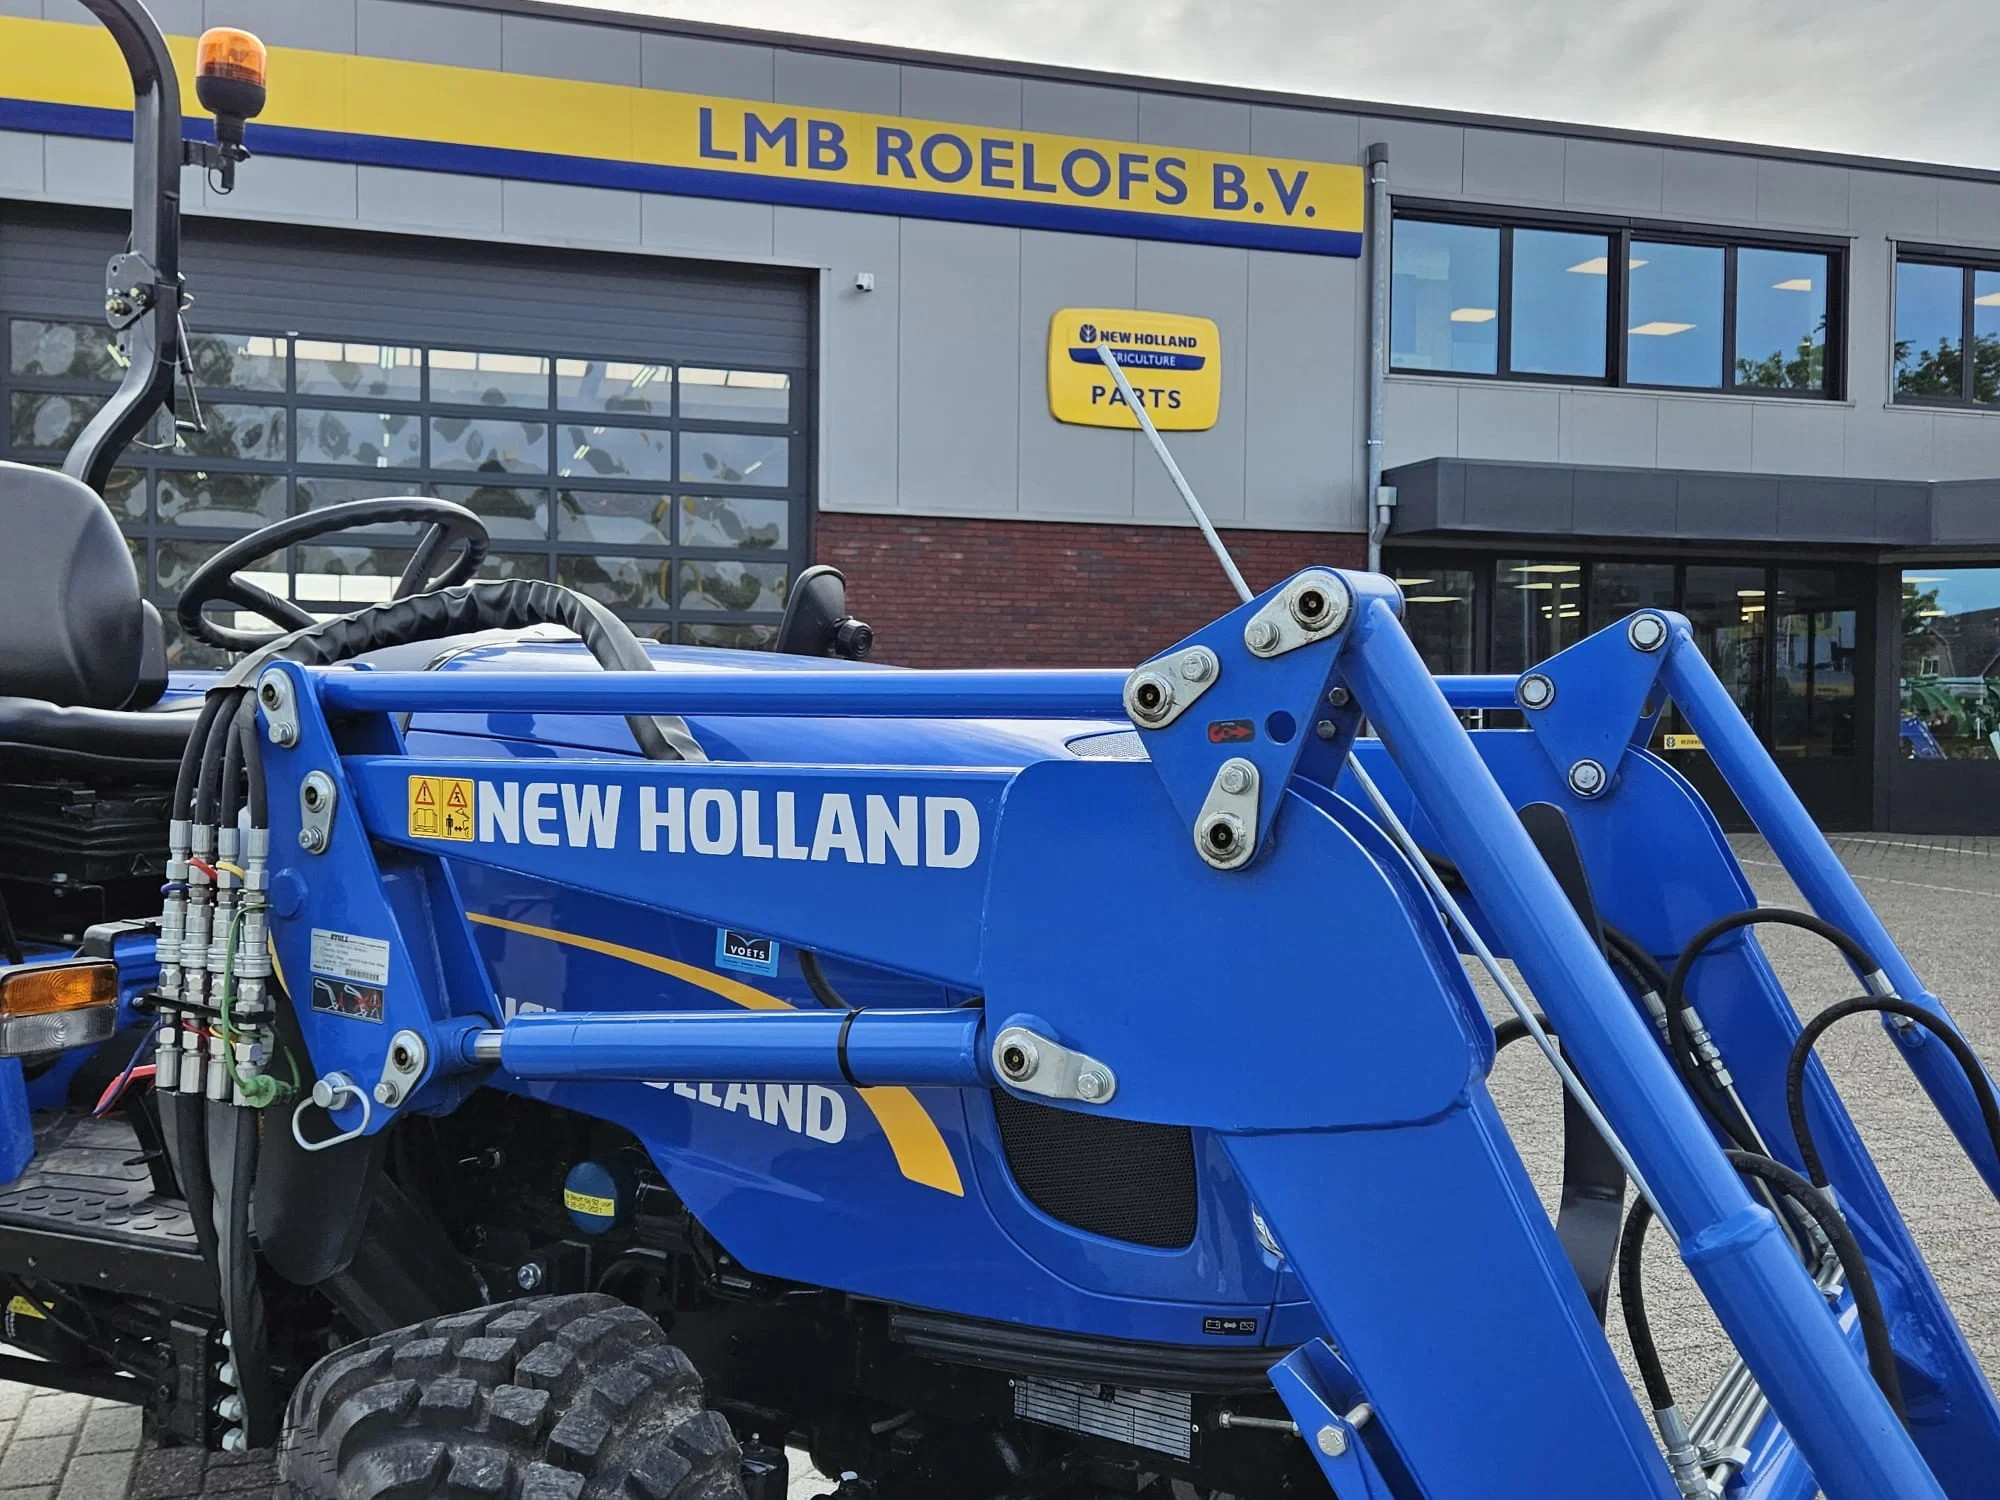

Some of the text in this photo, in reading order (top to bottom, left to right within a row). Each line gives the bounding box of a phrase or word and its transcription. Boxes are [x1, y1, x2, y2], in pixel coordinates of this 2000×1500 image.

[699, 107, 1317, 218] LMB ROELOFS B.V.
[1100, 330, 1197, 348] NEW HOLLAND
[1112, 351, 1176, 366] RICULTURE
[478, 780, 981, 870] NEW HOLLAND
[730, 944, 765, 959] VOETS
